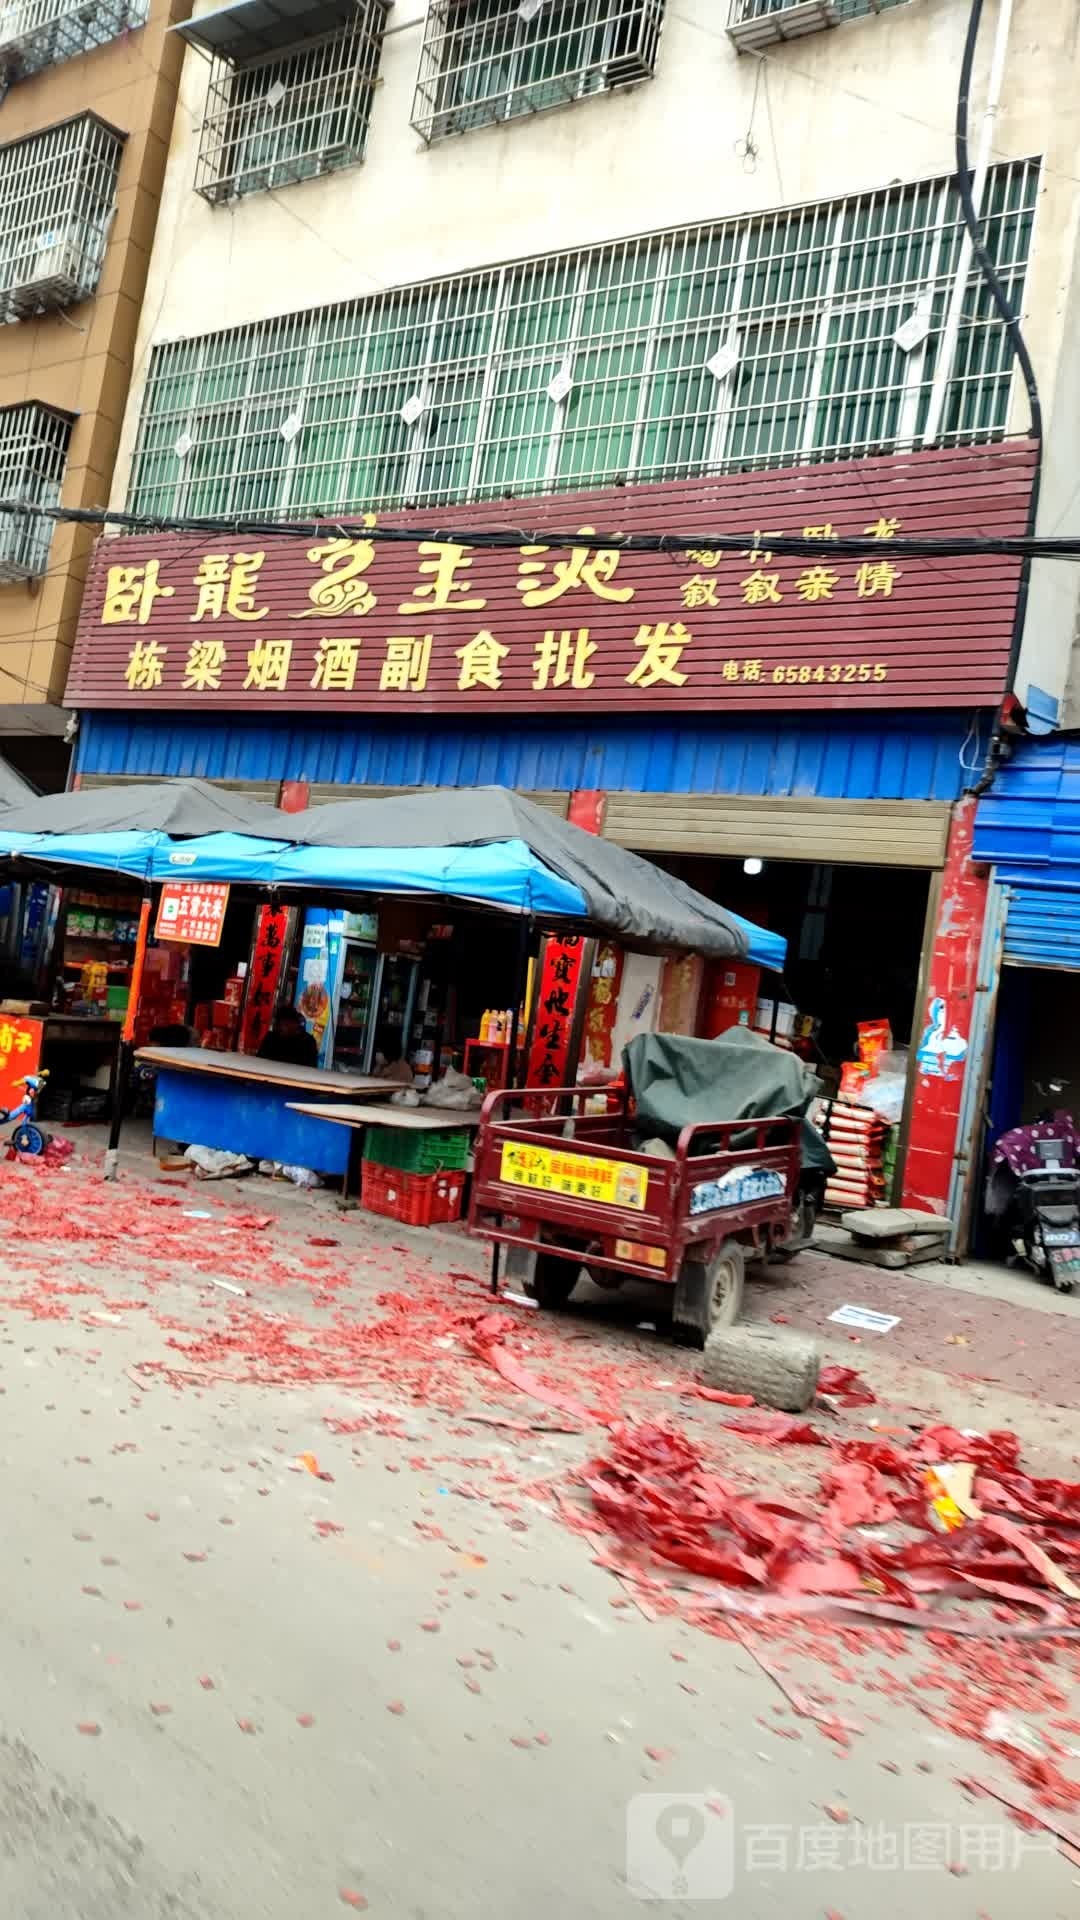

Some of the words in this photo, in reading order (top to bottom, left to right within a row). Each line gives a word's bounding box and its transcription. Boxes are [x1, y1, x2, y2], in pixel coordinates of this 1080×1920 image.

[680, 561, 902, 608] 叙叙亲情
[124, 621, 693, 692] 栋梁烟酒副食批发
